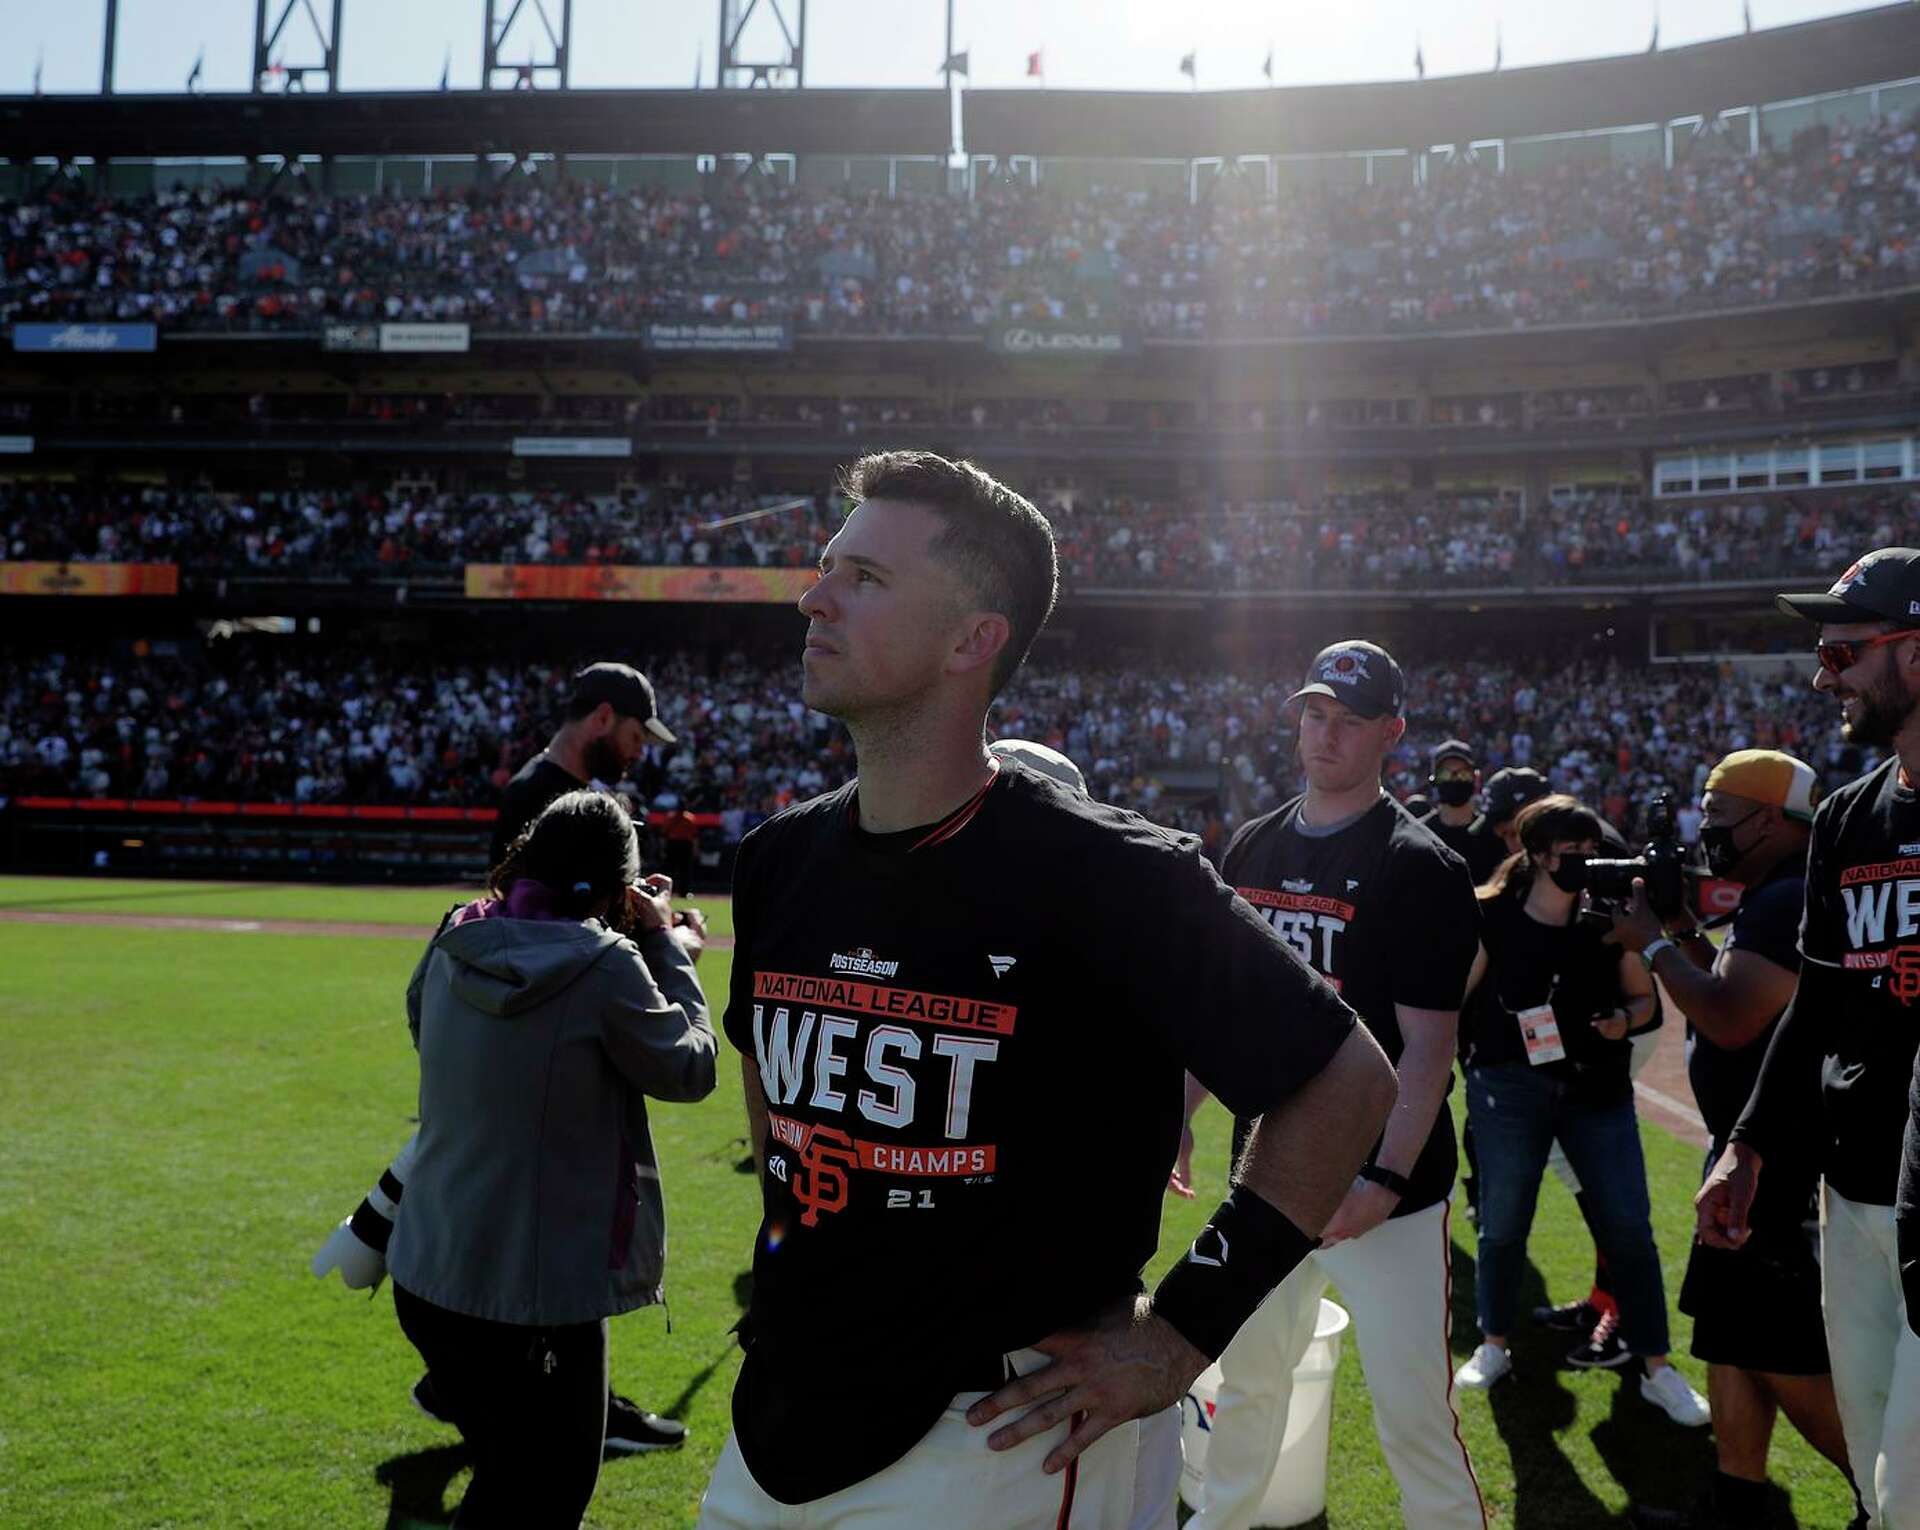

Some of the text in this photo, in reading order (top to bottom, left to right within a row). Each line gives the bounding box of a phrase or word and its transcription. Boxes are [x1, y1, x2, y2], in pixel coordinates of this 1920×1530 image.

[1036, 334, 1122, 349] LEXUS
[1260, 907, 1346, 974] EST
[830, 953, 899, 977] POSTSEASON
[760, 974, 999, 1029] NATIONAL LEAGUE
[753, 1003, 999, 1139] WEST
[873, 1146, 985, 1173] CHAMPS
[887, 1189, 935, 1209] 21
